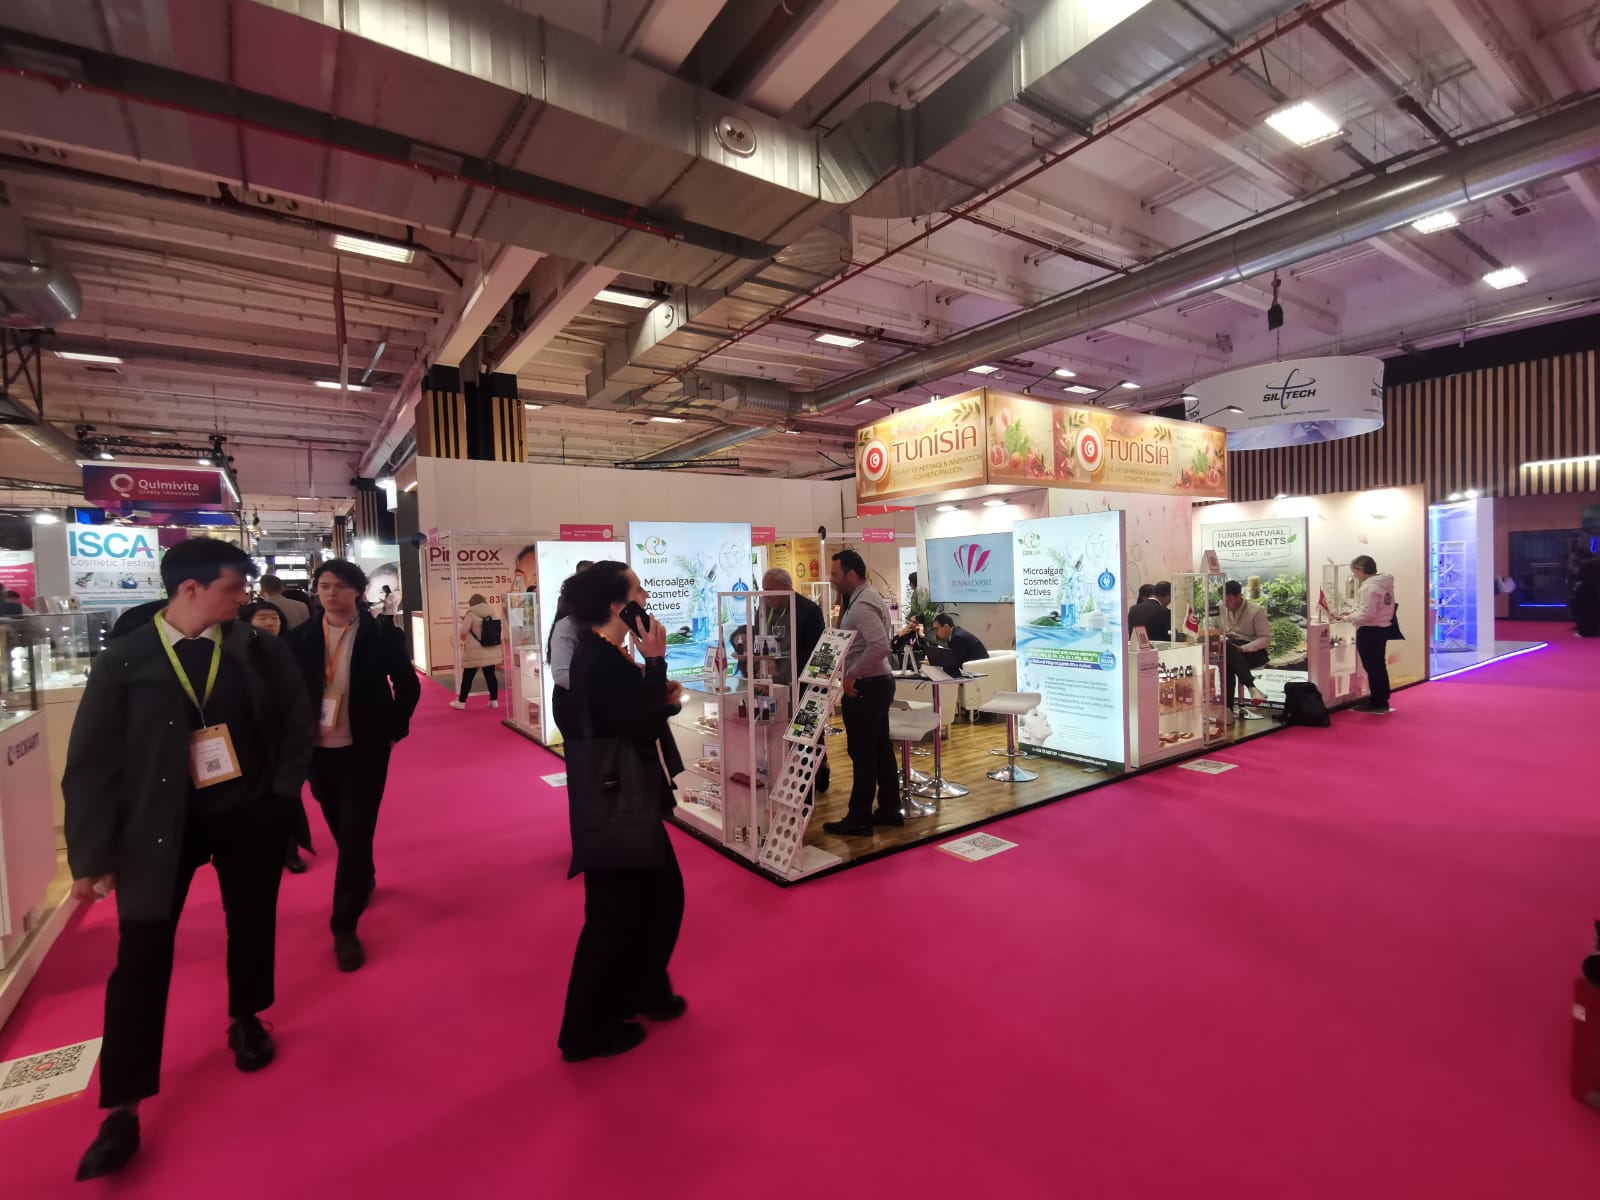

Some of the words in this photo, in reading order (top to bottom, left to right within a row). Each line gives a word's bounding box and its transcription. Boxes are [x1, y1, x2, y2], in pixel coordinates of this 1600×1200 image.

[138, 479, 200, 491] Quimivita
[1218, 531, 1247, 539] TUNISIA
[1249, 529, 1286, 538] NATURAL
[69, 531, 154, 558] ISCA
[1217, 537, 1287, 548] INGREDIENTS
[71, 559, 118, 567] Cosmetic
[121, 559, 156, 569] Testing
[1023, 567, 1064, 577] Microalgae
[495, 575, 513, 584] 35%
[644, 577, 695, 588] Microalgae
[1023, 577, 1059, 586] Cosmetic
[647, 588, 690, 599] Cosmetic
[1024, 588, 1052, 596] Actives
[645, 601, 681, 611] Actives
